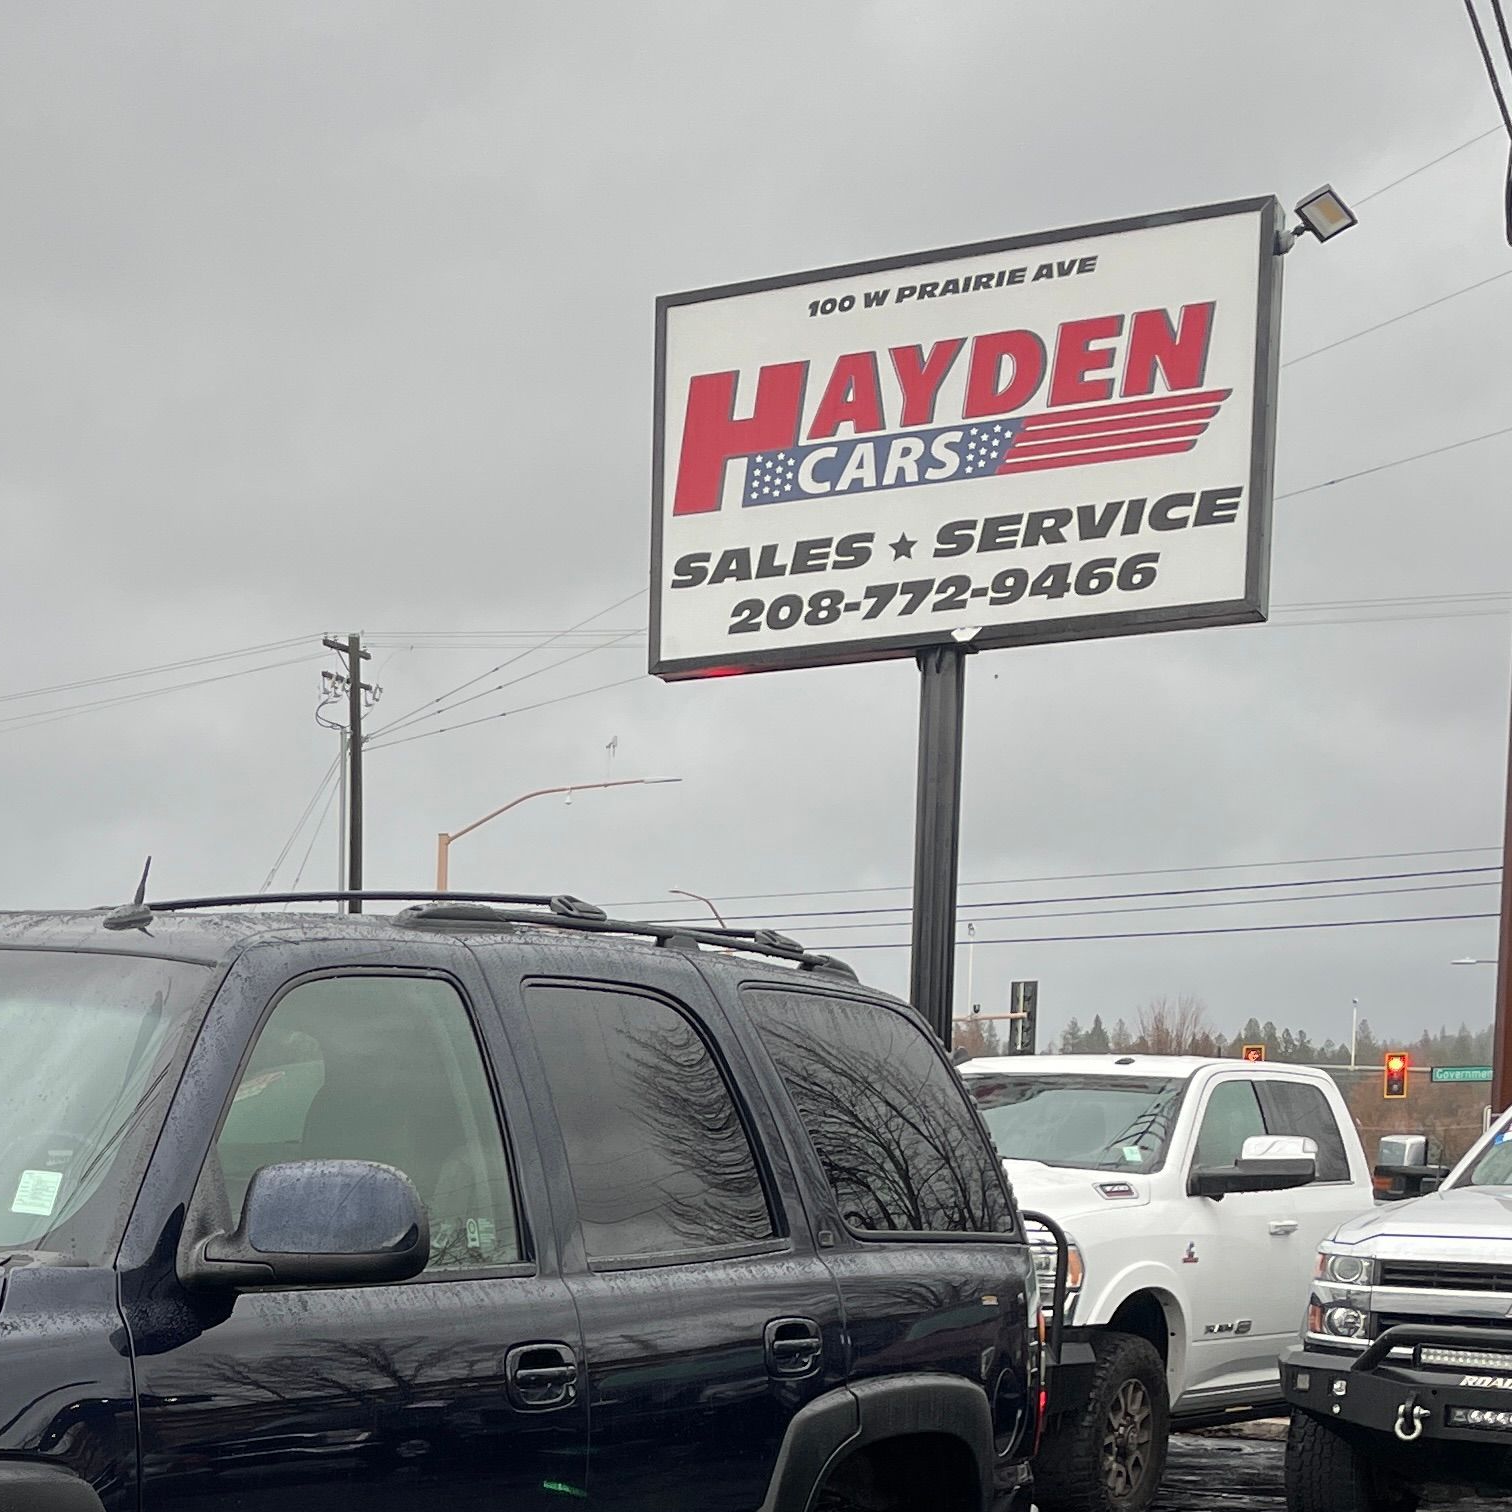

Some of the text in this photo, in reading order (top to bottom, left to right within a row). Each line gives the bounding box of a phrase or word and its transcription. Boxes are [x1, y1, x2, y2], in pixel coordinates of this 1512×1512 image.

[808, 255, 1099, 317] 100 W PRAIRIE AVE
[672, 300, 1217, 516] HAYDEN
[796, 429, 965, 496] CARS
[670, 485, 1245, 590] SALES SERVICE
[727, 552, 1161, 636] 208-772-9466
[1436, 1069, 1493, 1079] Governmen
